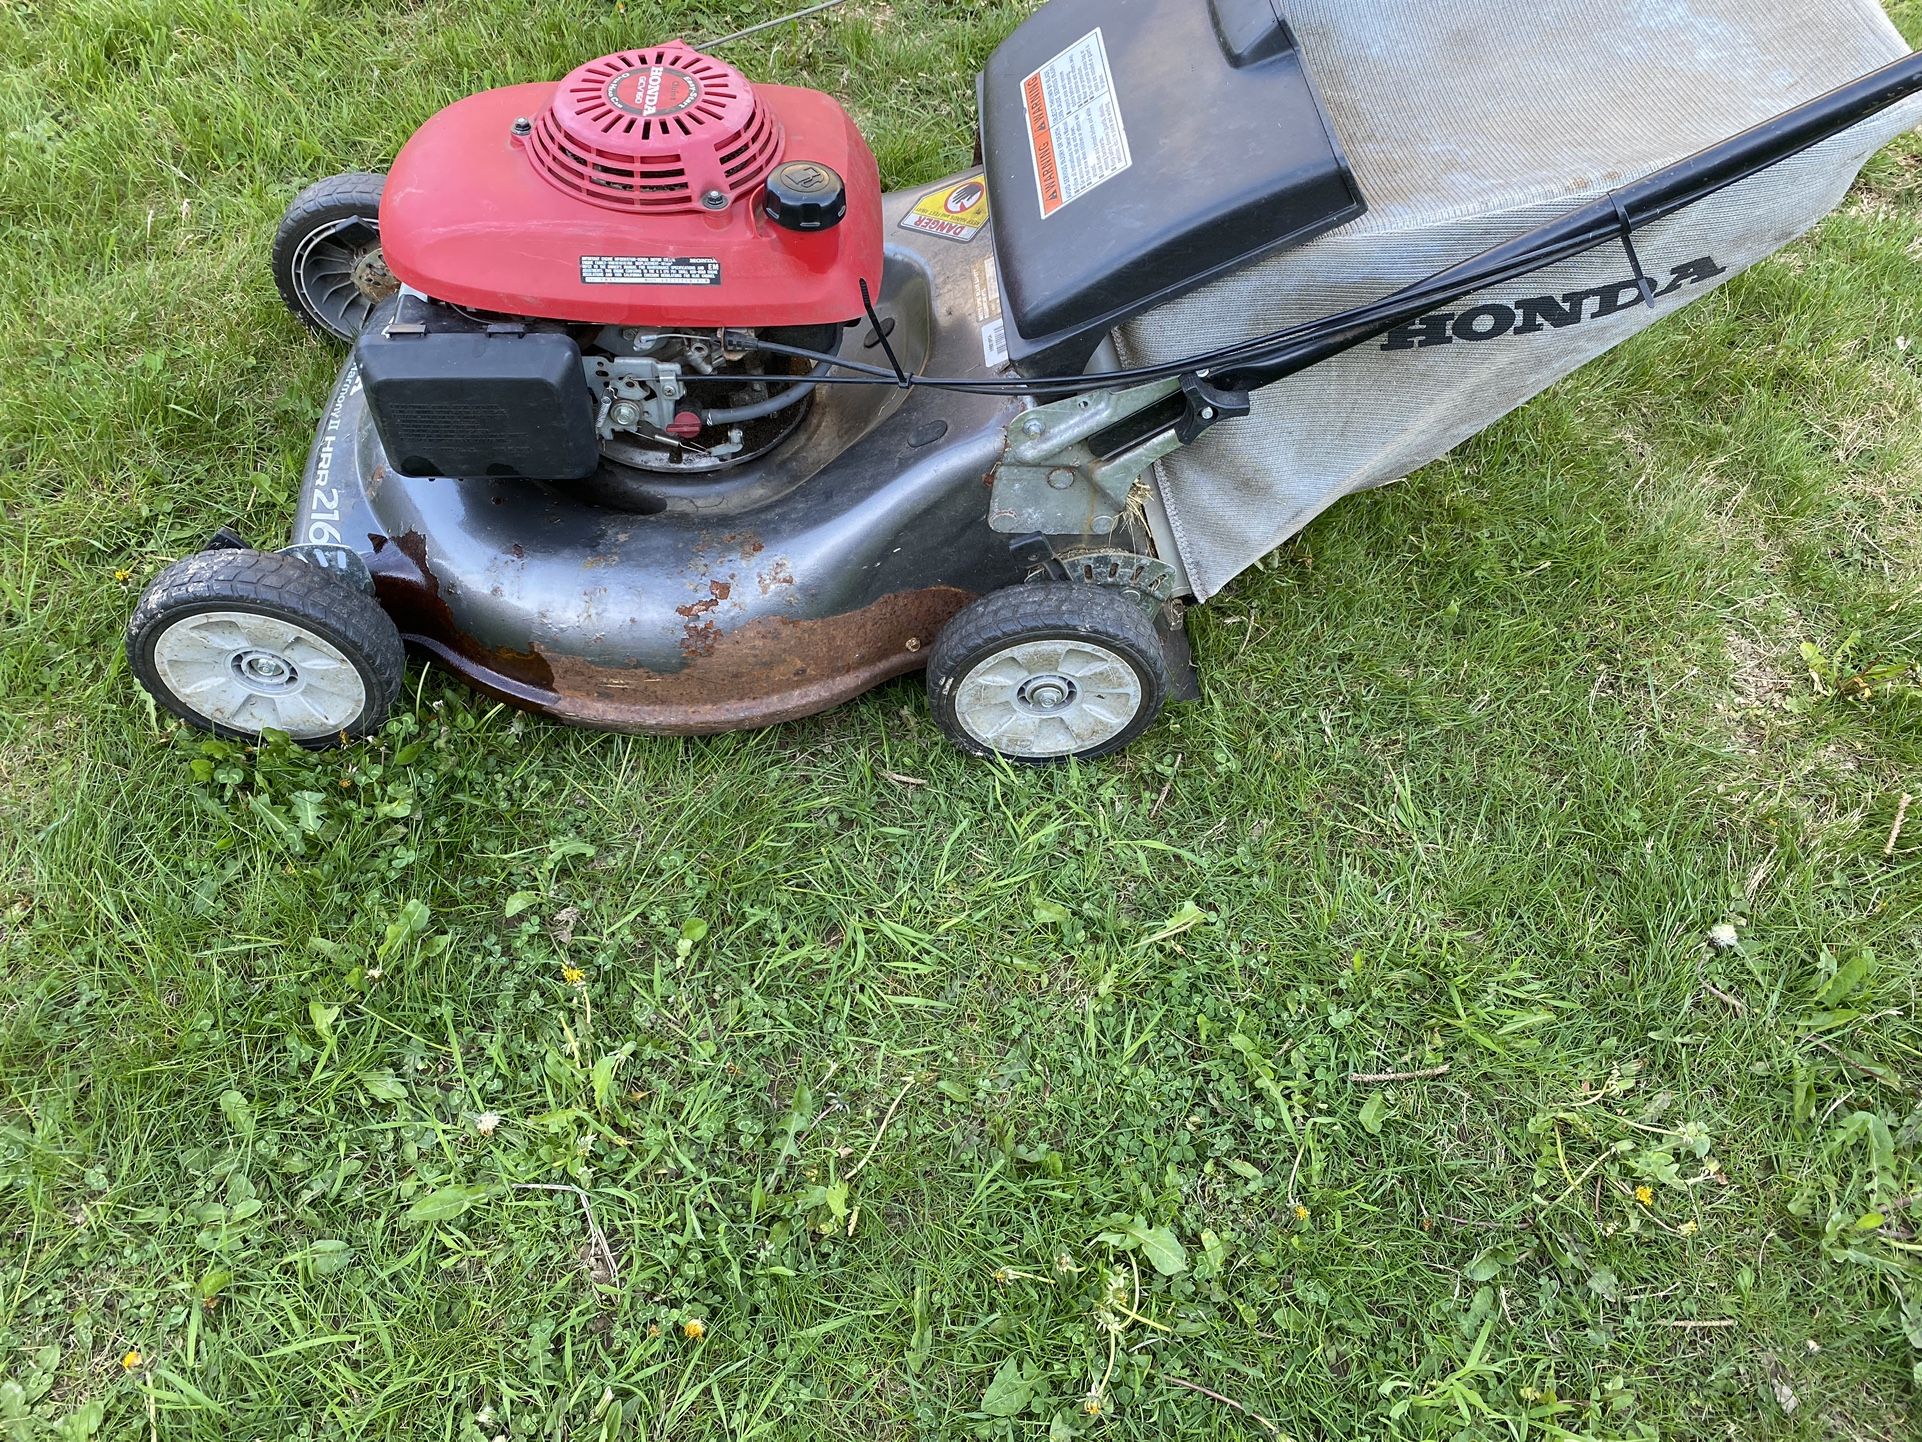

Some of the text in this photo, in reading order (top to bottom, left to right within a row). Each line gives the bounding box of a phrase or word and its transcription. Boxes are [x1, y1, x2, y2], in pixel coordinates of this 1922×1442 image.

[643, 66, 663, 116] HONDA
[1027, 75, 1044, 124] WARNING
[1038, 140, 1056, 193] WARNING
[914, 216, 965, 236] DANGER
[1380, 256, 1726, 351] HONDA
